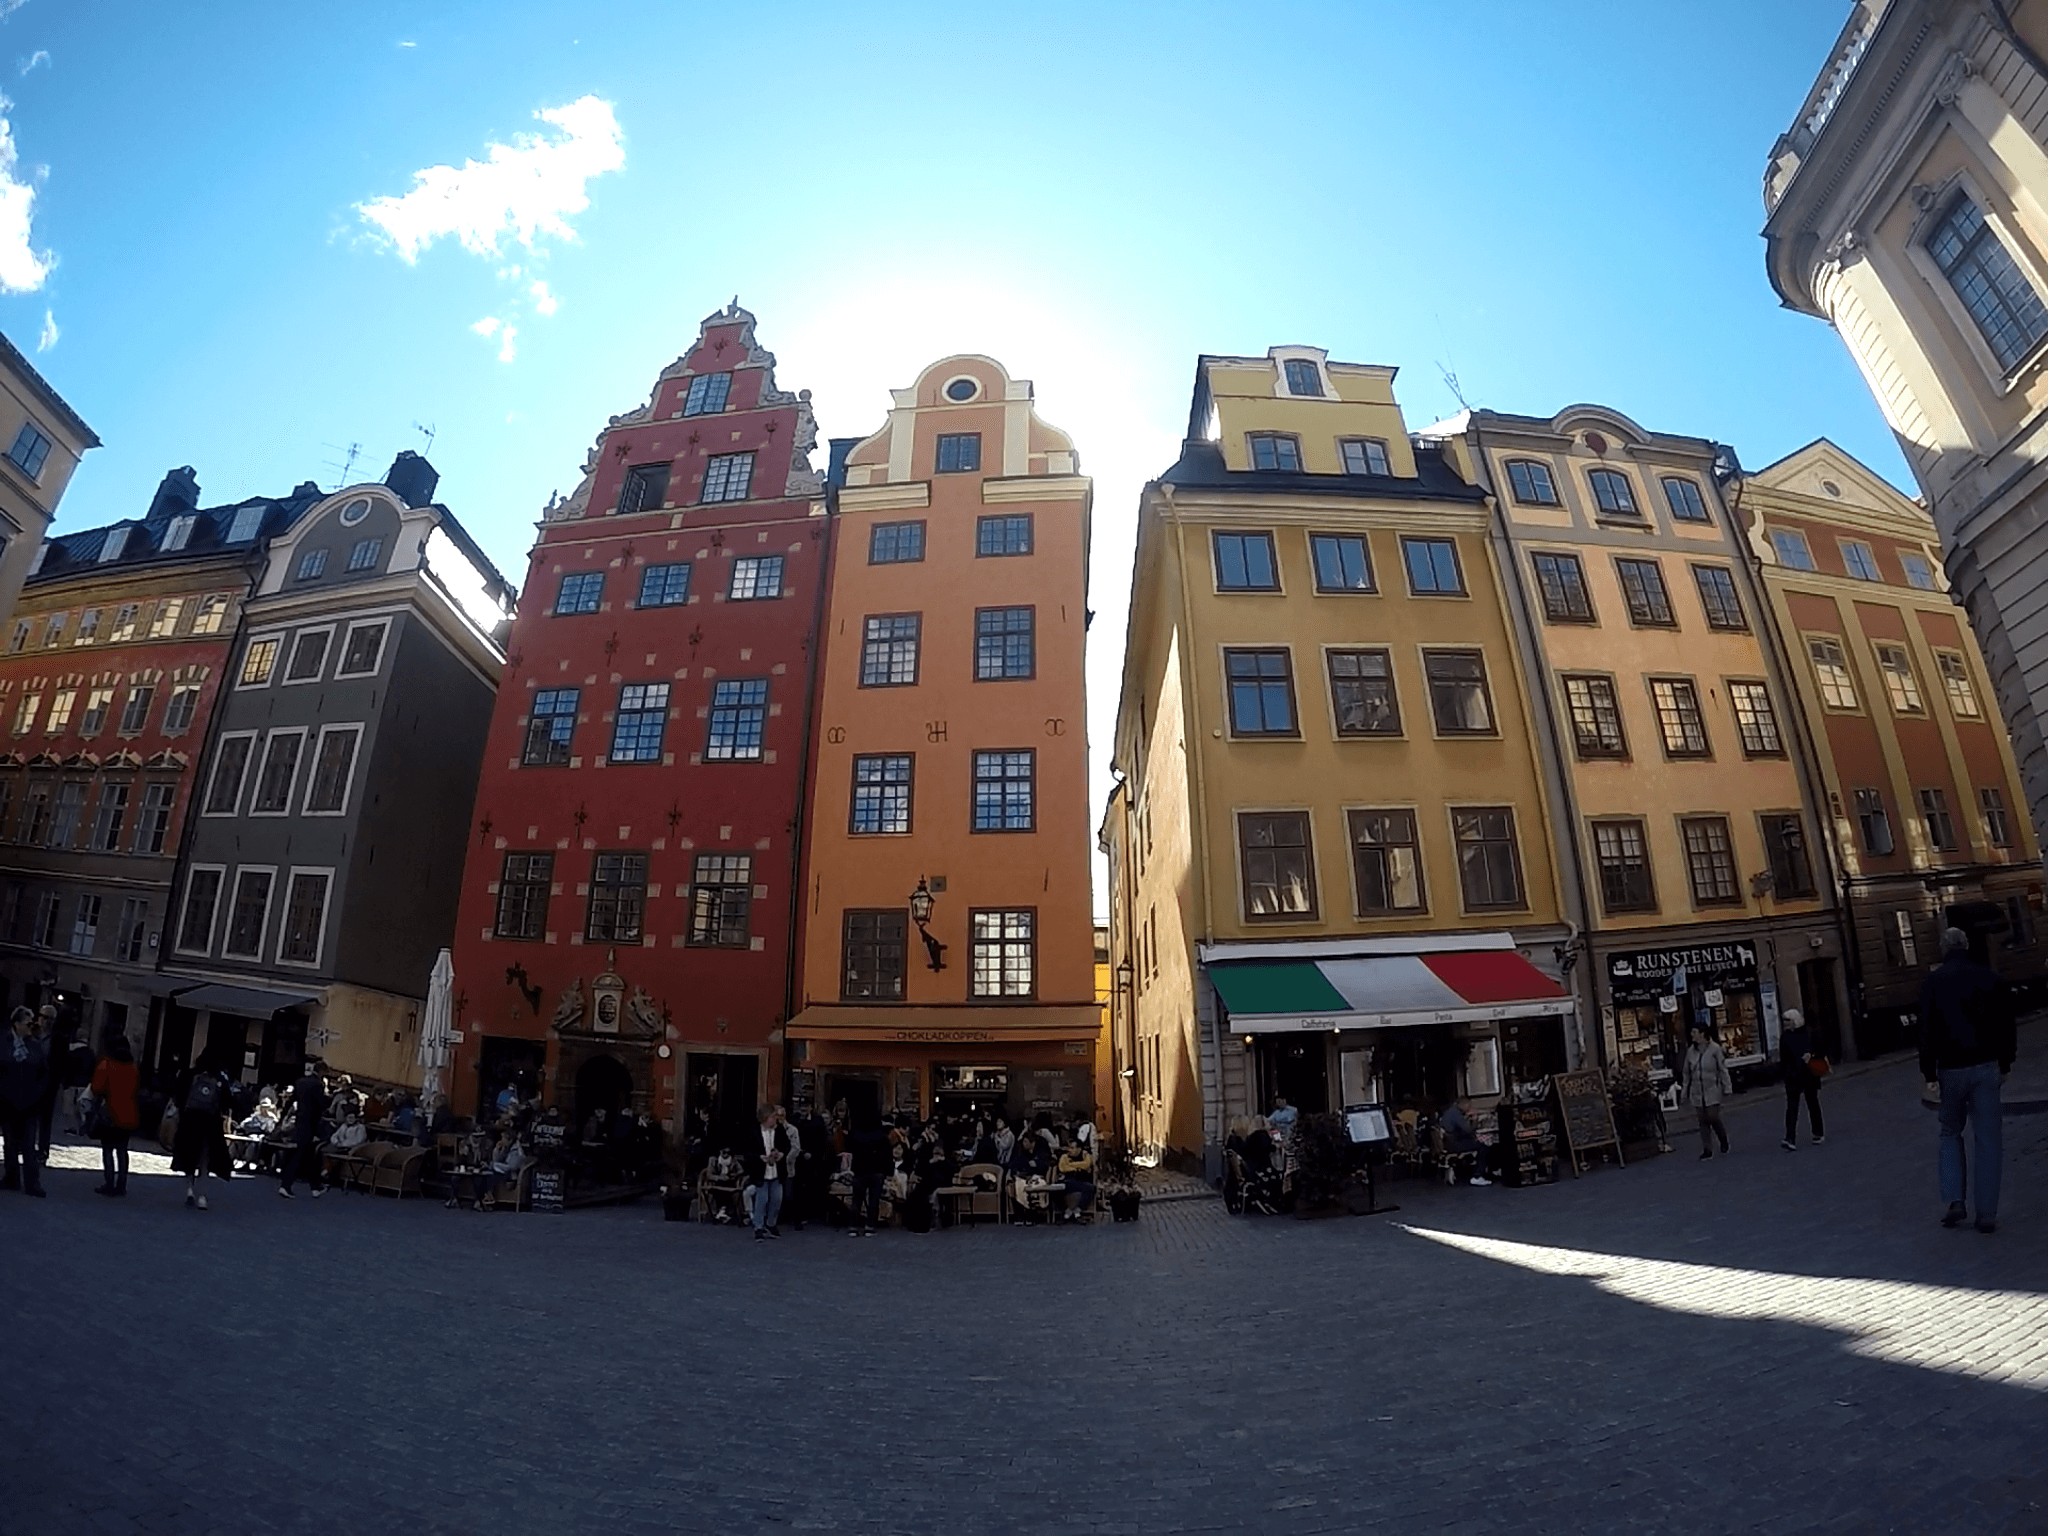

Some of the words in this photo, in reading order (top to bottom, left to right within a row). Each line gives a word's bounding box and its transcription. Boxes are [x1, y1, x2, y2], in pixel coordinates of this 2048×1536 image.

[1636, 945, 1734, 970] RUNSTENEN
[1635, 967, 1673, 979] WOODEN
[896, 1031, 988, 1041] CHOKLADKOPPEN
